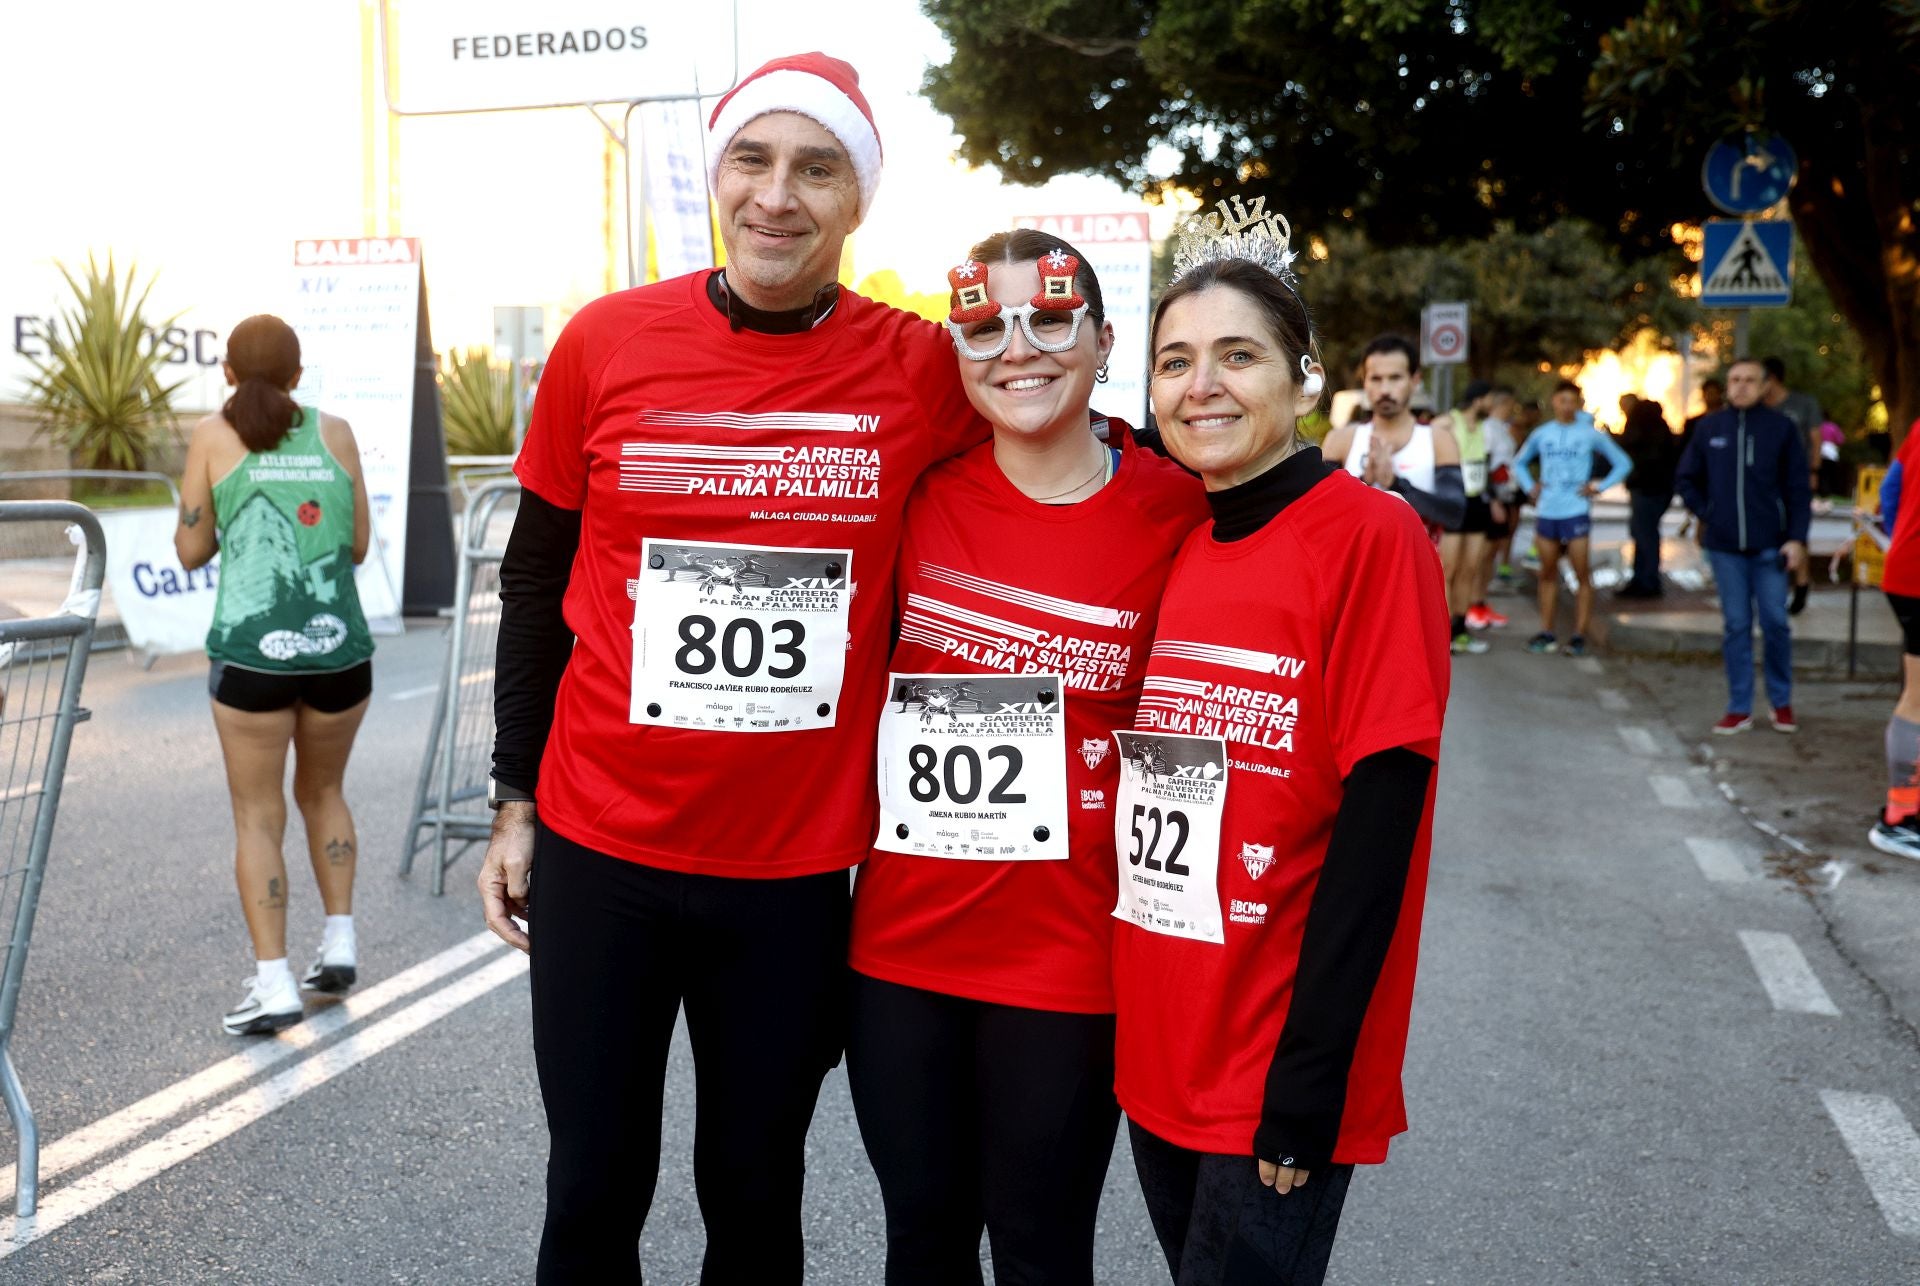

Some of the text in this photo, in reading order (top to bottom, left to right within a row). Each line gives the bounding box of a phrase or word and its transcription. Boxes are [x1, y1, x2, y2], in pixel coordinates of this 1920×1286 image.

[453, 26, 648, 60] FEDERADOS
[296, 239, 412, 265] SALIDA
[851, 415, 880, 432] XIV
[259, 454, 323, 468] ATLETISMO
[779, 446, 881, 465] CARRERA
[248, 468, 335, 483] TORREMOLINOS
[742, 464, 880, 481] SAN SILVESTRE
[687, 478, 879, 499] PALMA PALMILLA
[750, 510, 877, 523] MÁLAGA CIUDAD SALUDABLE
[781, 577, 845, 589] XIV
[700, 598, 754, 607] PALMA
[766, 595, 838, 603] SILVESTRE
[1114, 609, 1141, 629] XIV
[675, 614, 807, 679] 803
[1032, 630, 1131, 662] CARRERA
[944, 638, 1124, 692] PALMA PAMILLA
[995, 638, 1129, 677] SAN SILVESTRE
[1270, 654, 1306, 679] XIV
[669, 680, 813, 693] FRANCISCO JAVIER RUBIO RODRÍGUEZ
[995, 702, 1058, 714] XIV
[1201, 682, 1299, 716] CARRERA
[1176, 697, 1297, 732] SAN SILVESTRE
[1150, 709, 1293, 752] PALMA PALMILLA
[909, 744, 1027, 804] 802
[1234, 760, 1290, 778] SALUDABLE
[1165, 783, 1216, 796] SILVESTRE
[1168, 778, 1216, 789] CARRERA
[1141, 786, 1162, 796] PALMA
[1163, 790, 1214, 802] PALMILLA
[929, 810, 1007, 819] JIMENA RUBIO MARTÍN
[1129, 803, 1190, 877] 522
[1156, 880, 1184, 893] RODRÍGUEZ
